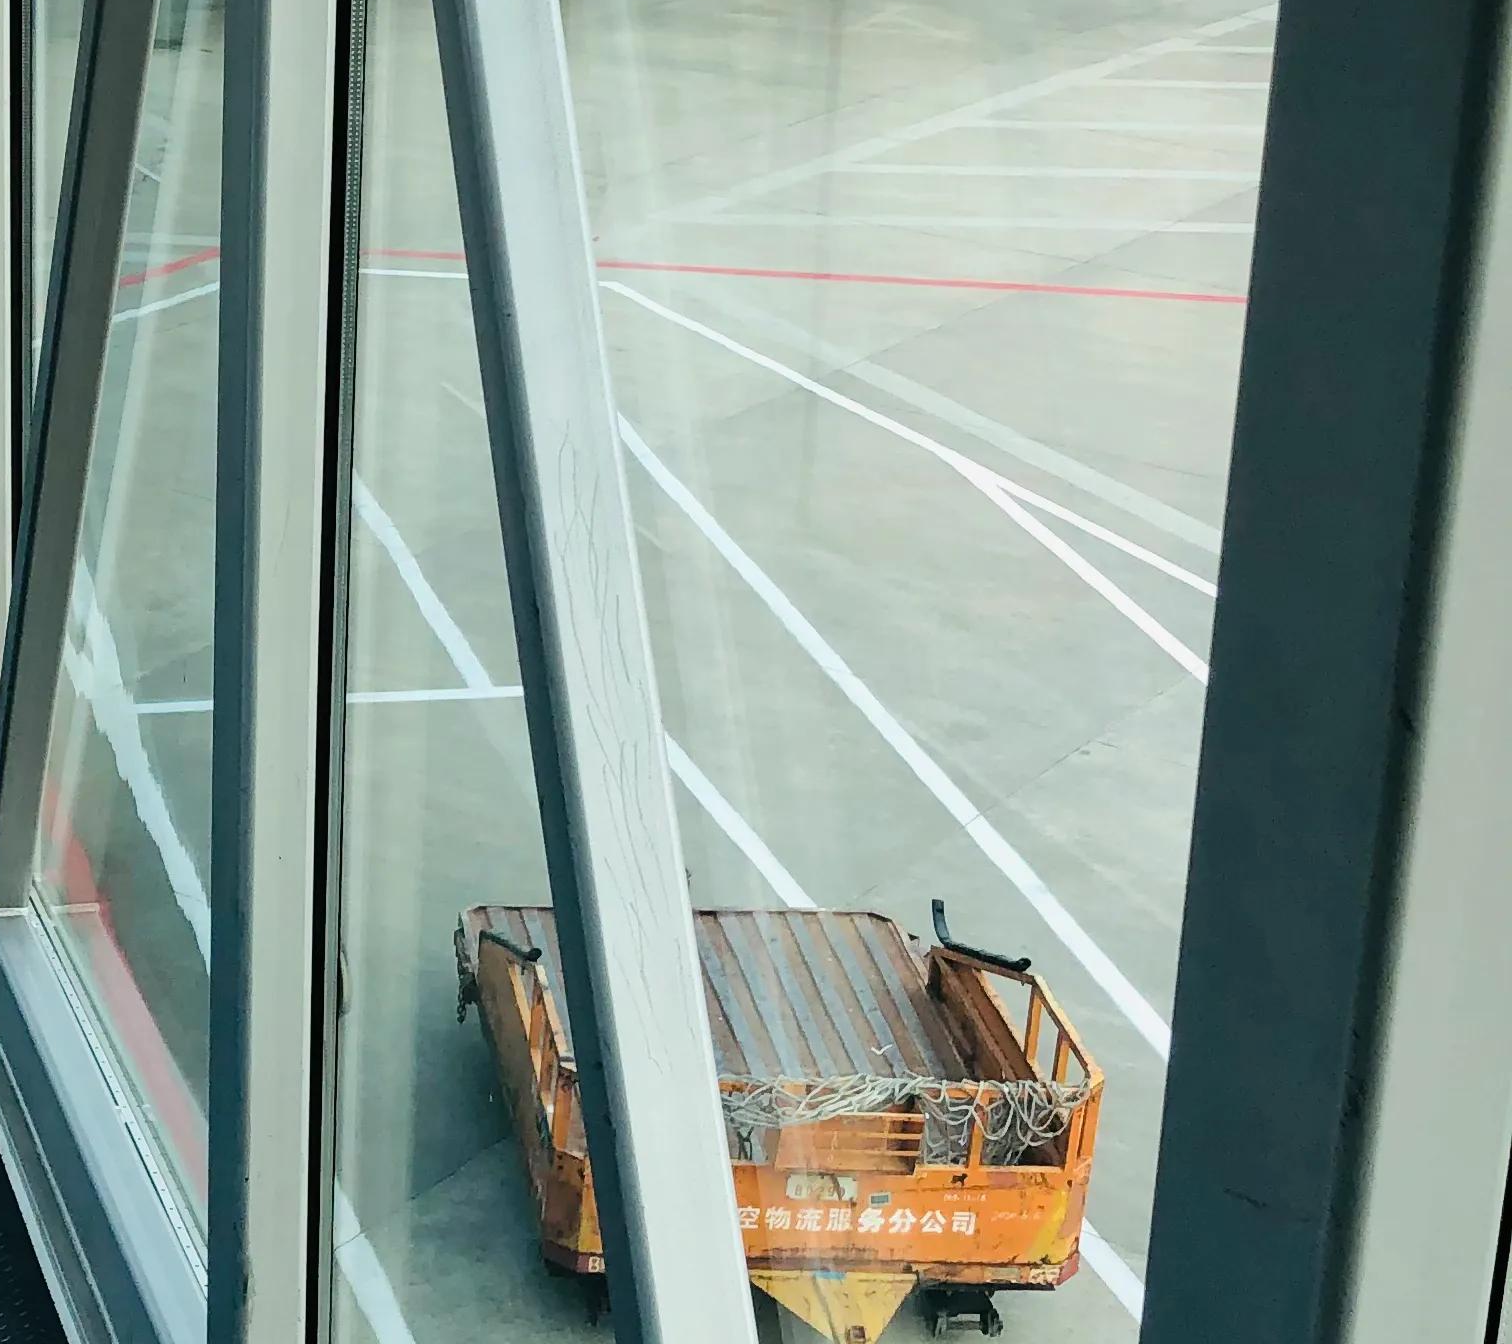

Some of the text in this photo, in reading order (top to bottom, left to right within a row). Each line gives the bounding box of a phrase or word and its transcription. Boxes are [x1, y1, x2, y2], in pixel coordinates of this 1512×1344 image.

[737, 1206, 977, 1236] 空物流服务分公司
